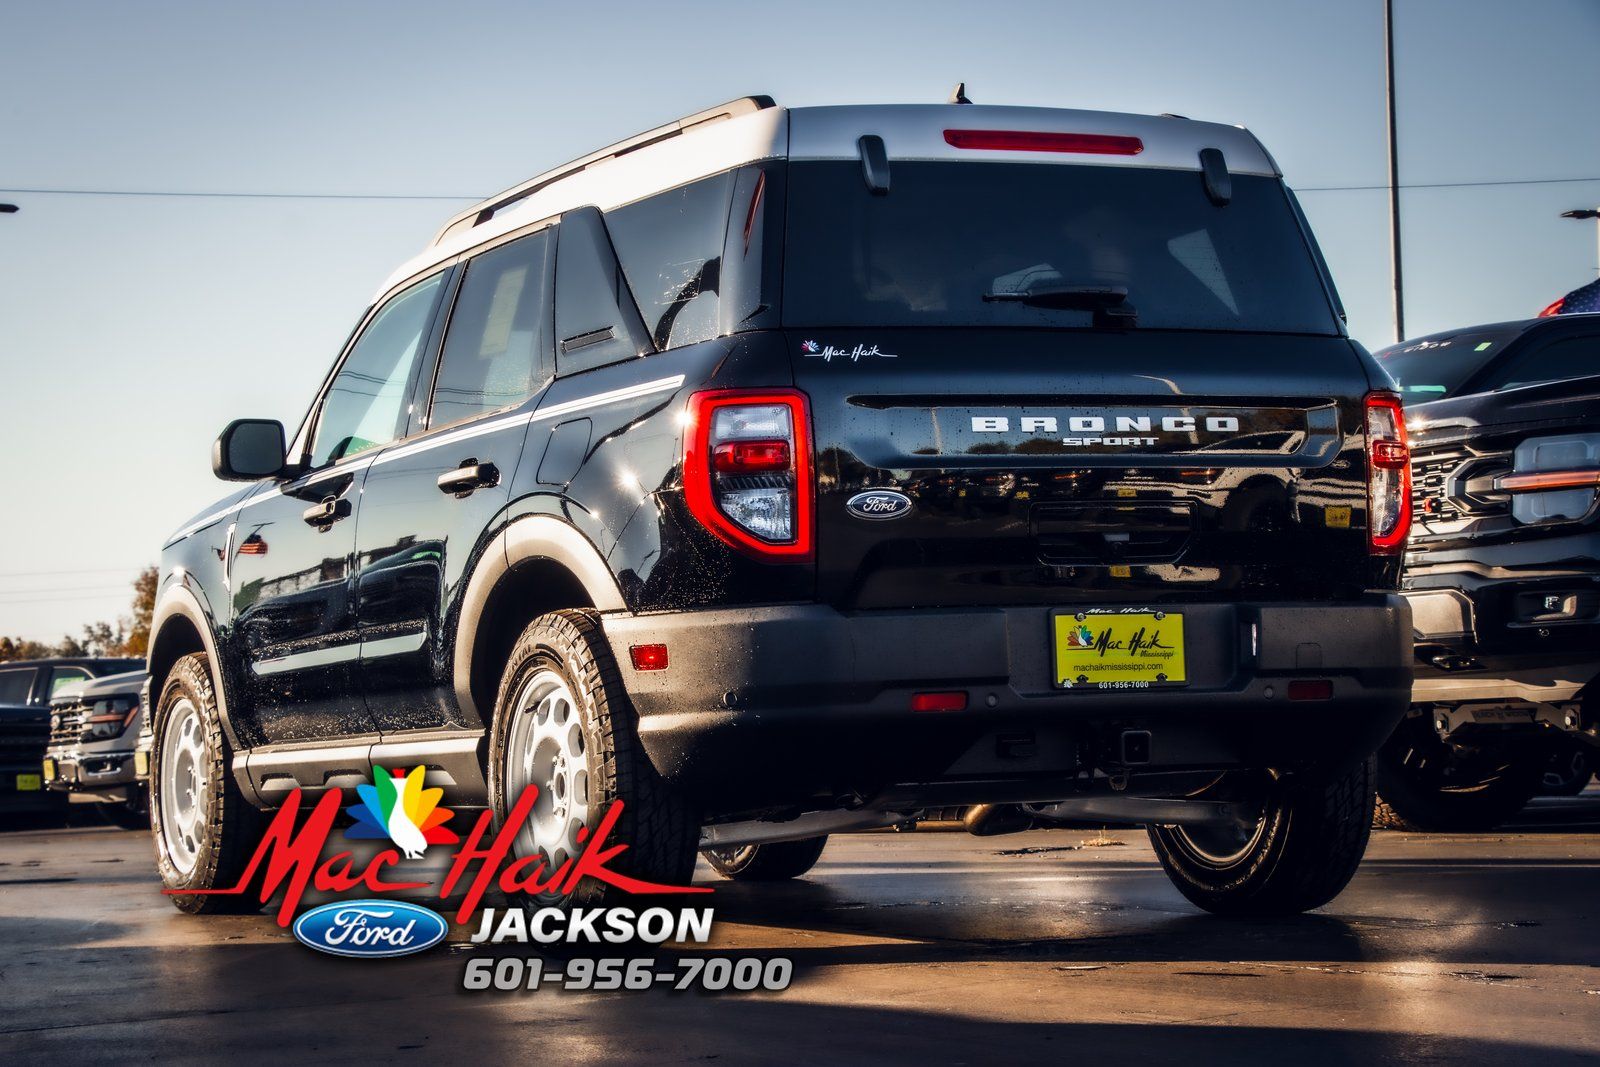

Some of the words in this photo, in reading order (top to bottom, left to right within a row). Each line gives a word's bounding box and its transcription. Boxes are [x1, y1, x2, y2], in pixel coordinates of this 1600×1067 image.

[804, 346, 850, 363] Mac
[851, 343, 898, 362] Haik
[971, 416, 1239, 432] BRONCO
[1062, 437, 1159, 446] SPORT
[1127, 627, 1174, 657] Haik
[1140, 650, 1175, 660] Mississippi
[1073, 662, 1164, 672] machaikmississippi.com
[1098, 681, 1149, 689] 601-956-7000
